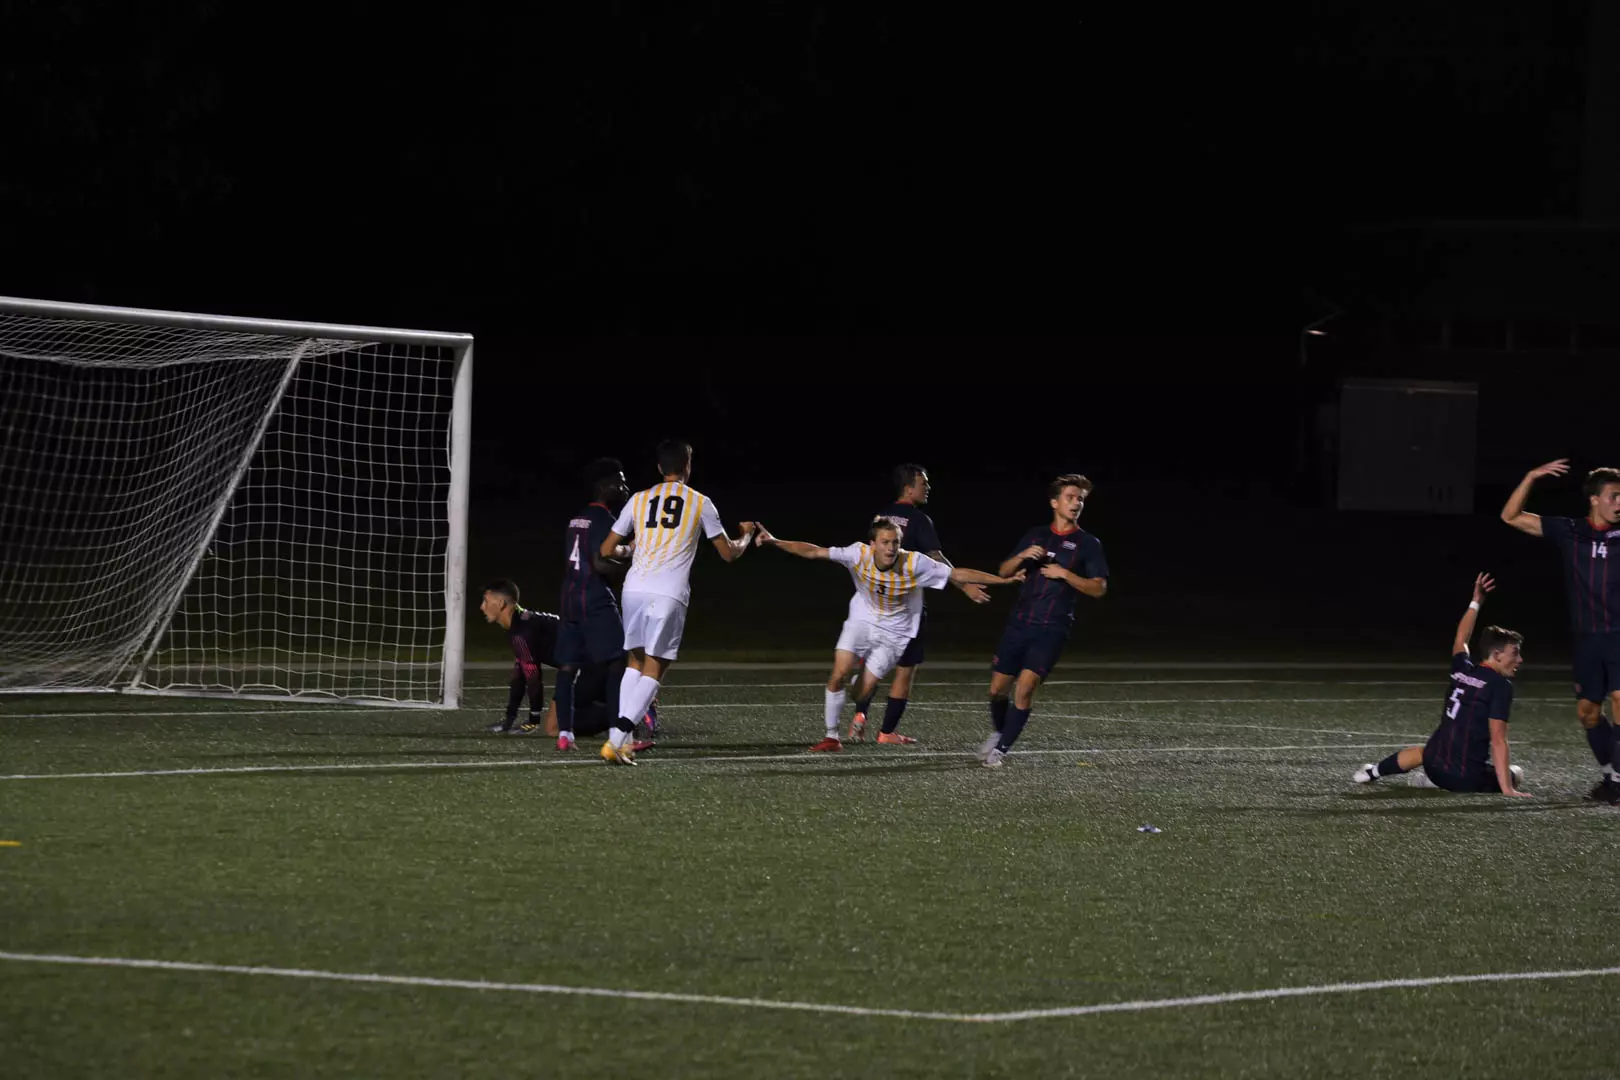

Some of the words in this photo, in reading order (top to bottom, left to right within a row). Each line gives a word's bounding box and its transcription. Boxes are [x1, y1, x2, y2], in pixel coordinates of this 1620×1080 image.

[646, 495, 684, 528] 19
[569, 534, 581, 570] 4
[1592, 541, 1608, 558] 14
[1446, 688, 1465, 720] 5
